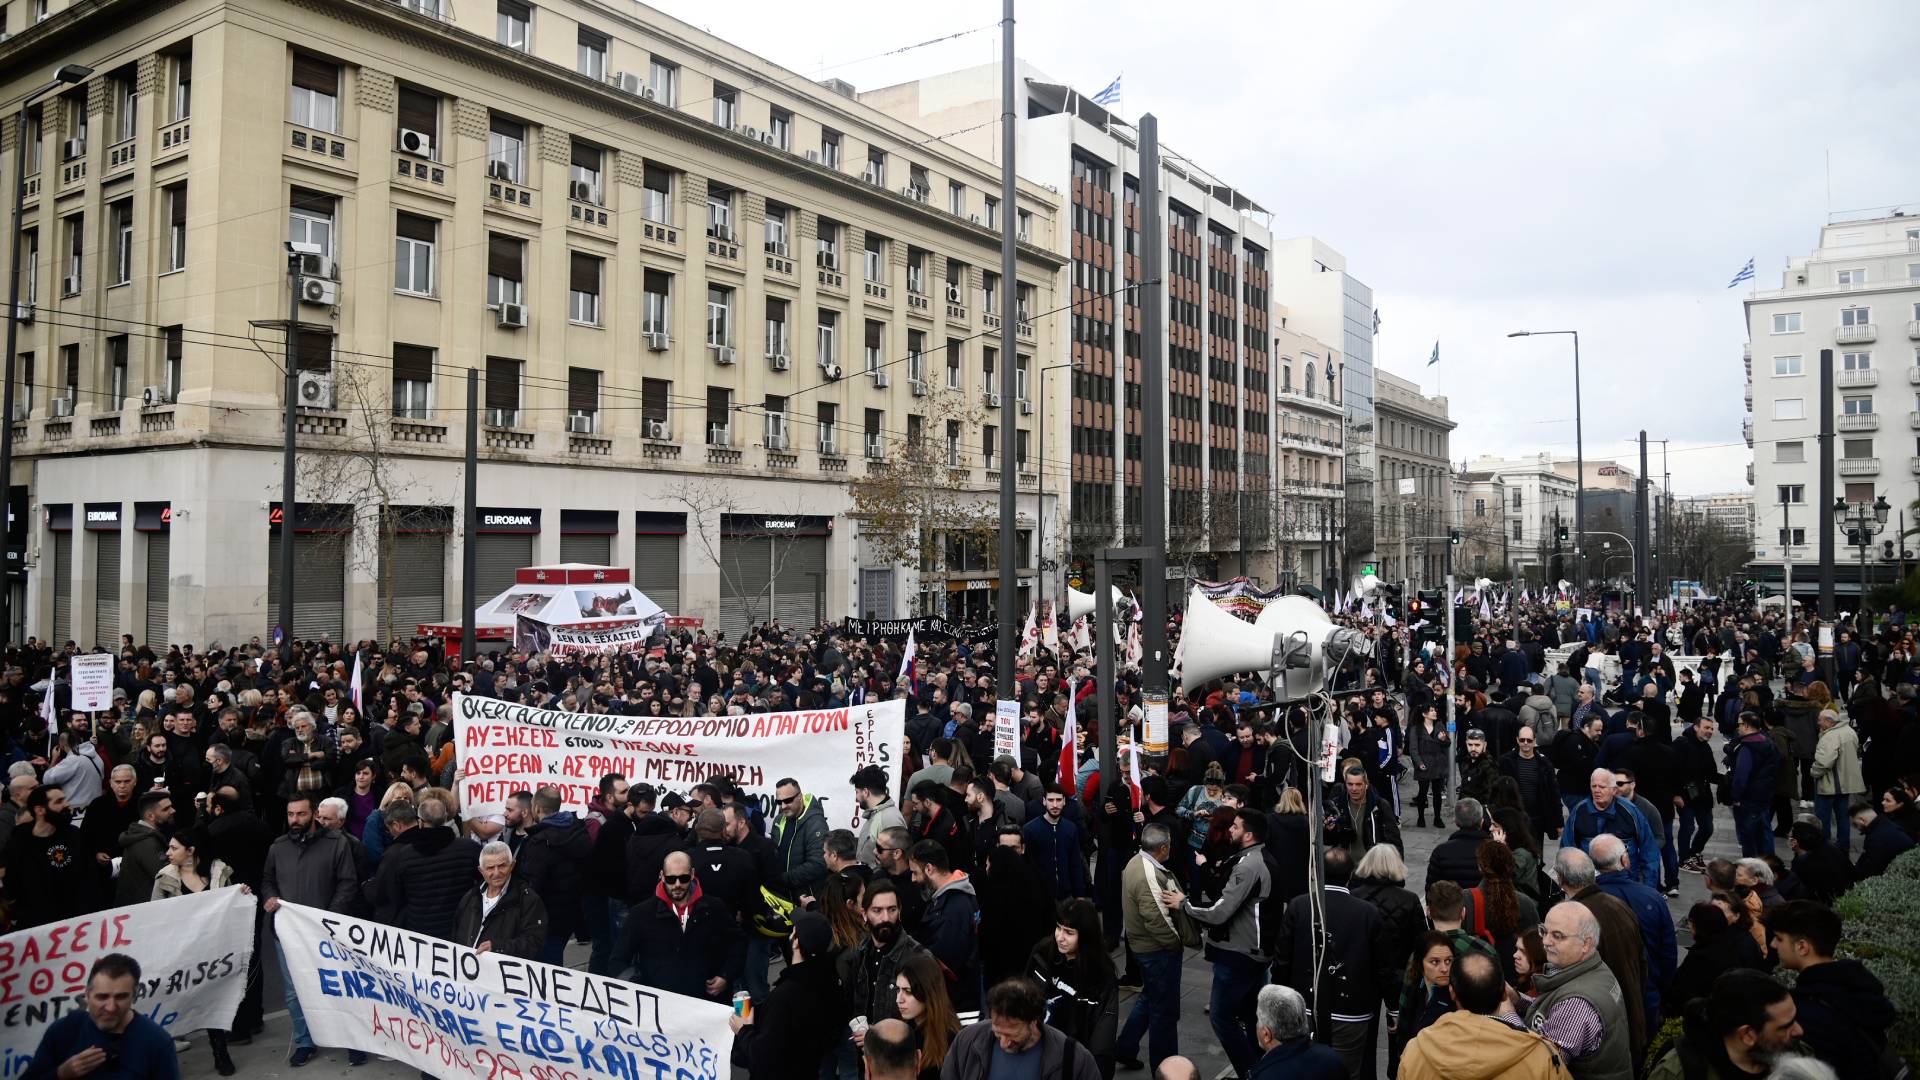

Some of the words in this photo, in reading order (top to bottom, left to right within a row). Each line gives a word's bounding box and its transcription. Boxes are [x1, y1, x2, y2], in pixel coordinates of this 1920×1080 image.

[87, 511, 118, 521] EUROBANK
[484, 515, 532, 525] EUROBANK
[966, 580, 986, 590] BOOKS
[557, 634, 575, 644] ΔΕΝ
[577, 635, 591, 644] ΘΑ
[593, 630, 642, 644] ΞΕΧΑΣΤΕΙ
[466, 726, 559, 748] ΑΥΞΗΣΕΙΣ
[632, 717, 750, 737] ΑΕΡΟΔΡΟΜΙΟ
[752, 709, 849, 738] ΑΠΑΙΤΟΥΝ
[465, 753, 543, 776] ΔΩΡΕΑΝ
[562, 754, 635, 779] ΑΣΦΑΛΗ
[645, 758, 763, 787] ΜΕΤΑΚΙΝΗΣΗ
[166, 952, 234, 995] RISES
[321, 918, 480, 982] ΣΩΜΑΤΕΙΟ
[498, 960, 664, 1034] ΕΝΕΔΕΠ
[412, 971, 490, 1013] μισθών
[513, 998, 576, 1034] ΣΣΕ
[496, 1021, 575, 1064] ΕΔΩ
[574, 1034, 640, 1080] ΚΑΙ
